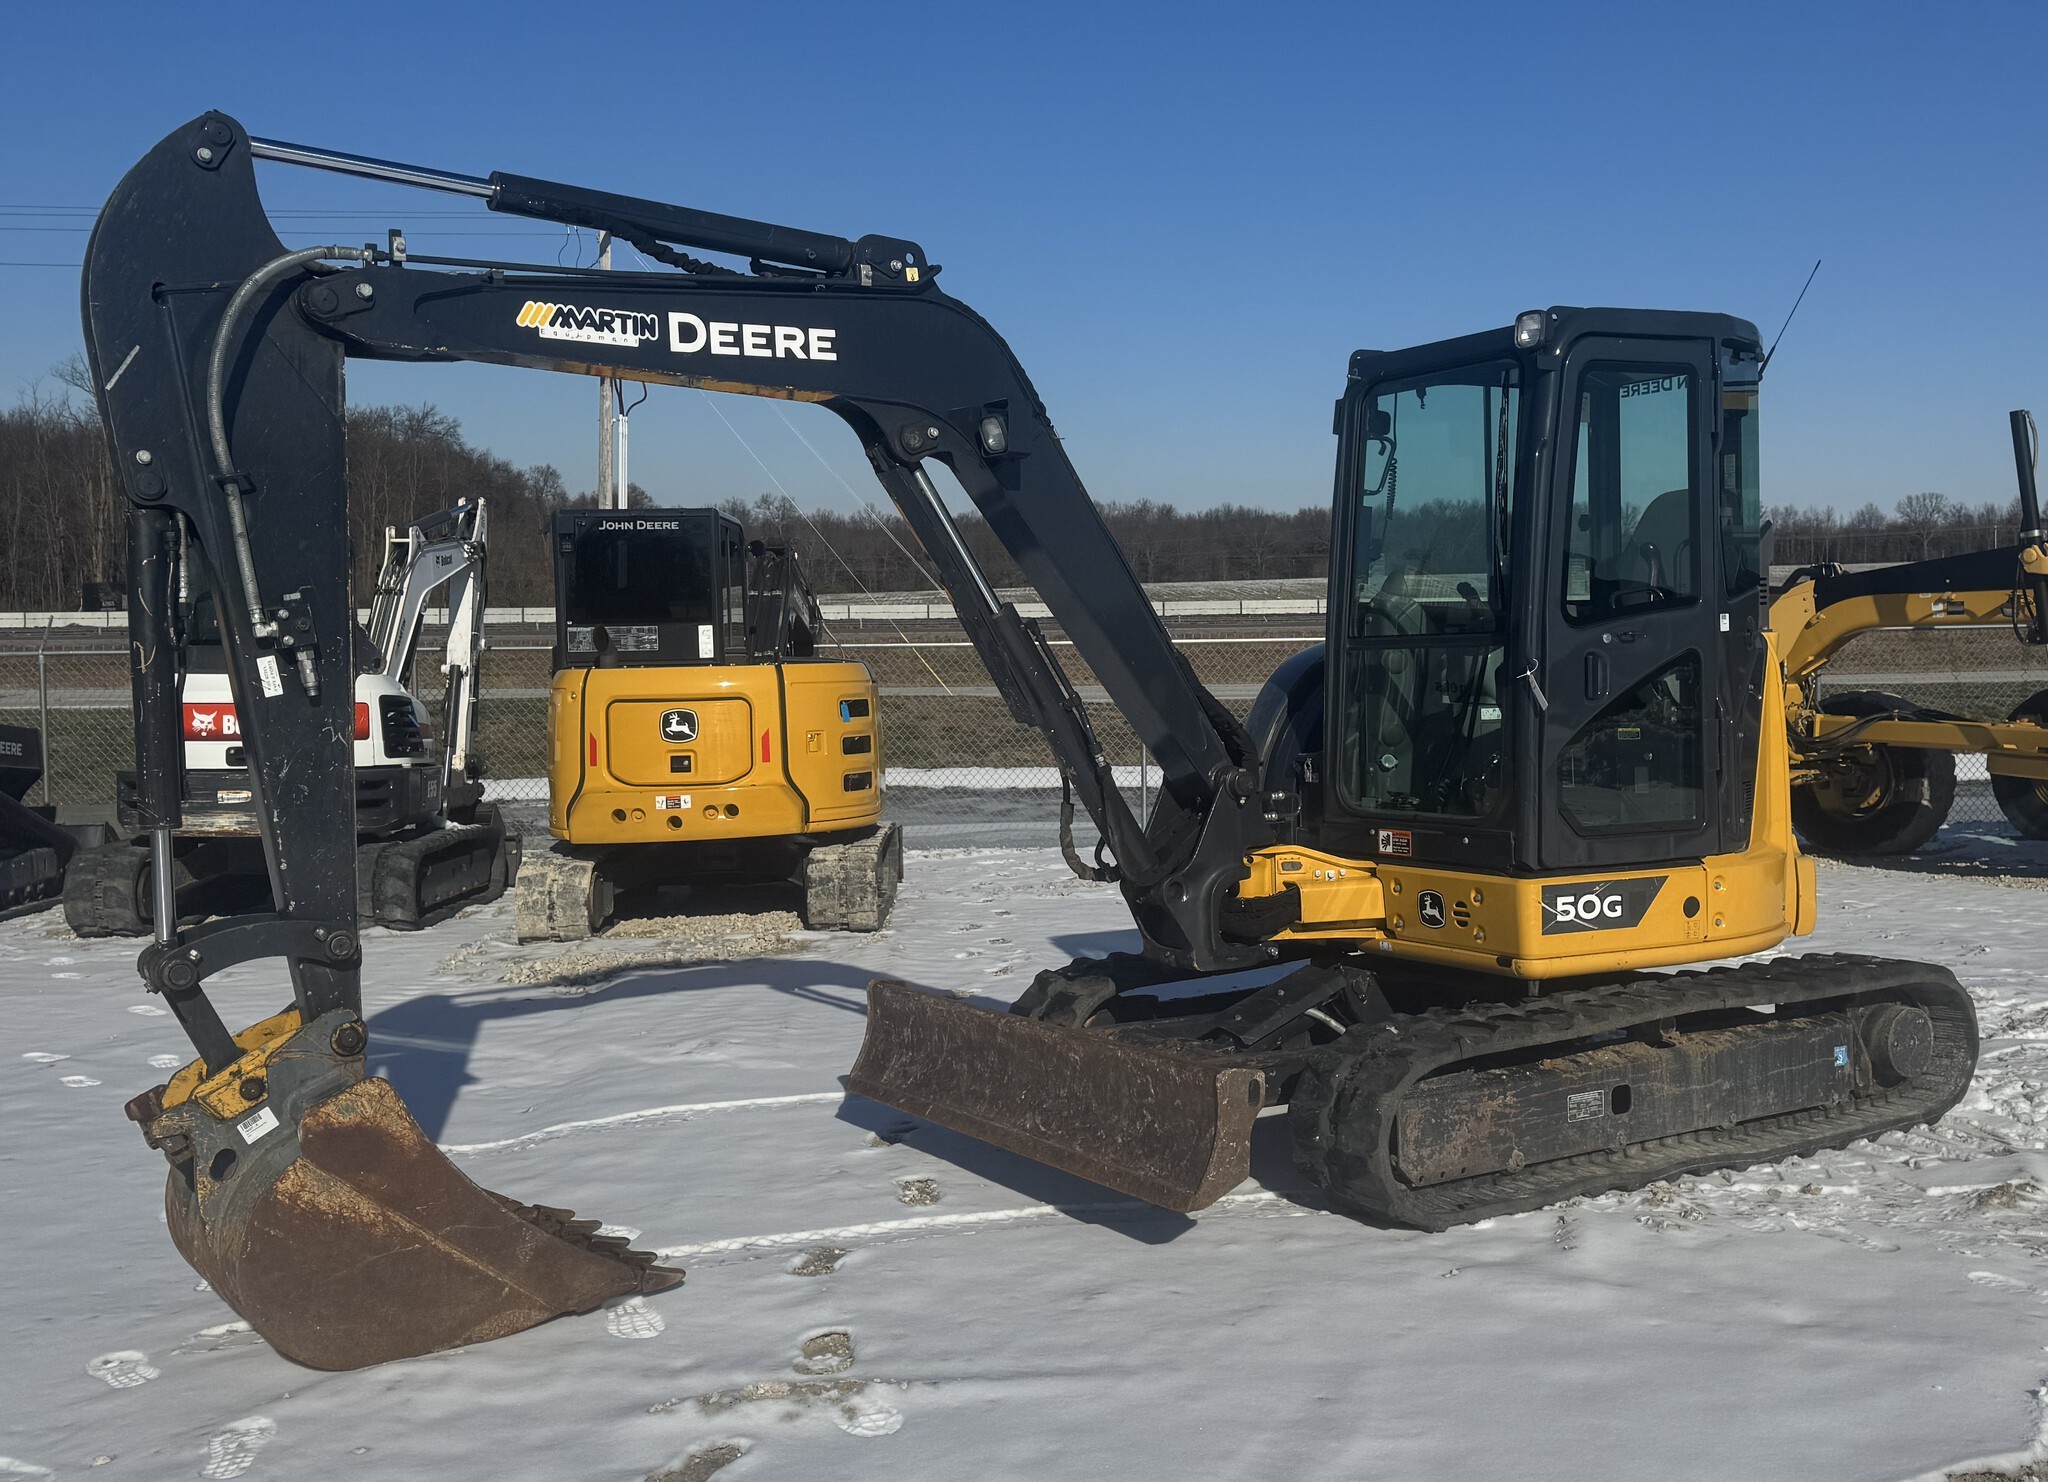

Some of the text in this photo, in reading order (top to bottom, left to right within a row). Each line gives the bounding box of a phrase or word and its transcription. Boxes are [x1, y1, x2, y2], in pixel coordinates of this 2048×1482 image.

[549, 304, 656, 338] MARTIN
[668, 311, 838, 361] DEERE
[598, 520, 680, 531] JOHN DEERE
[1556, 894, 1623, 922] 50G
